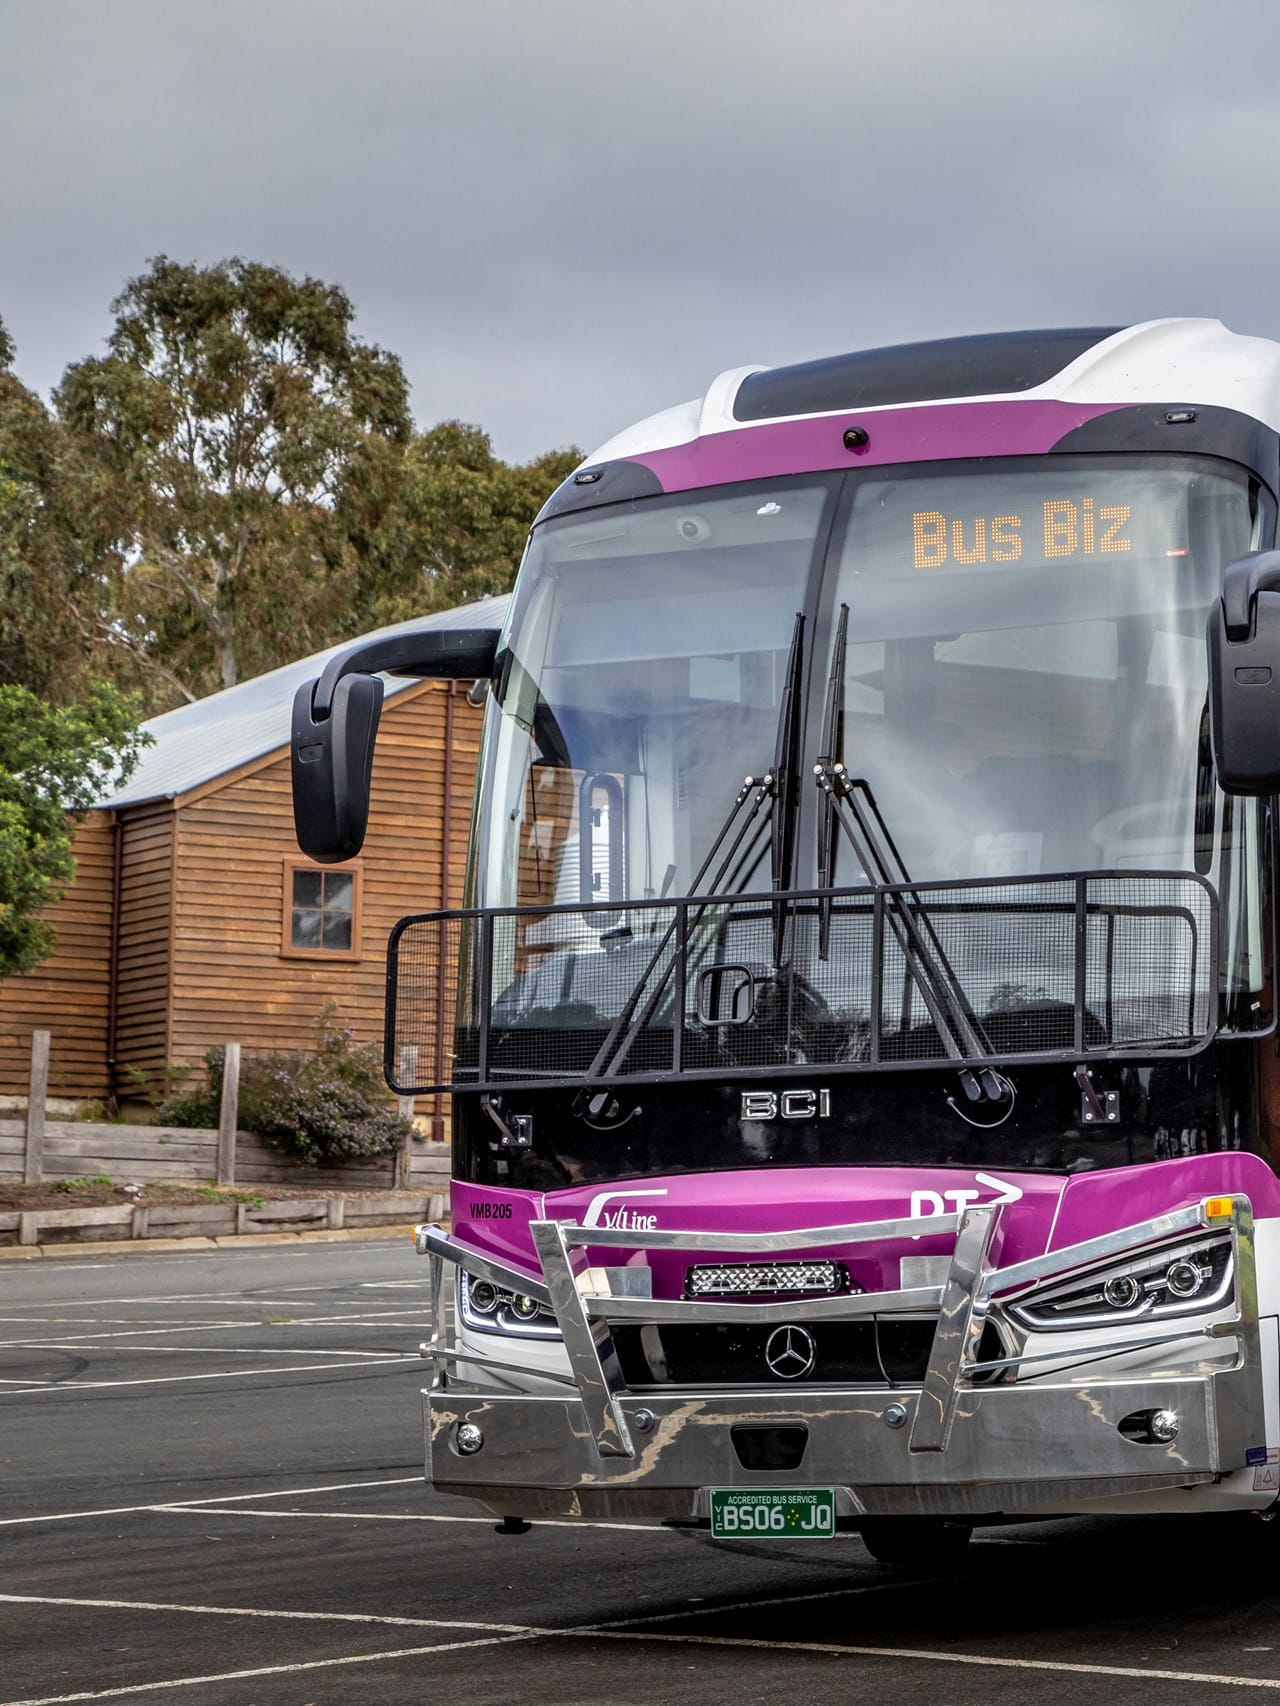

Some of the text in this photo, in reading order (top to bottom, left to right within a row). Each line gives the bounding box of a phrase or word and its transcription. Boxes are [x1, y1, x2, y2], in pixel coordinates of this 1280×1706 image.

[912, 498, 1131, 568] Bus Biz
[741, 1088, 830, 1120] BCI
[469, 1204, 513, 1219] VMB 205
[728, 1495, 818, 1505] ACCREDITED BUS SERVICE
[723, 1504, 832, 1531] BS06 JQ
